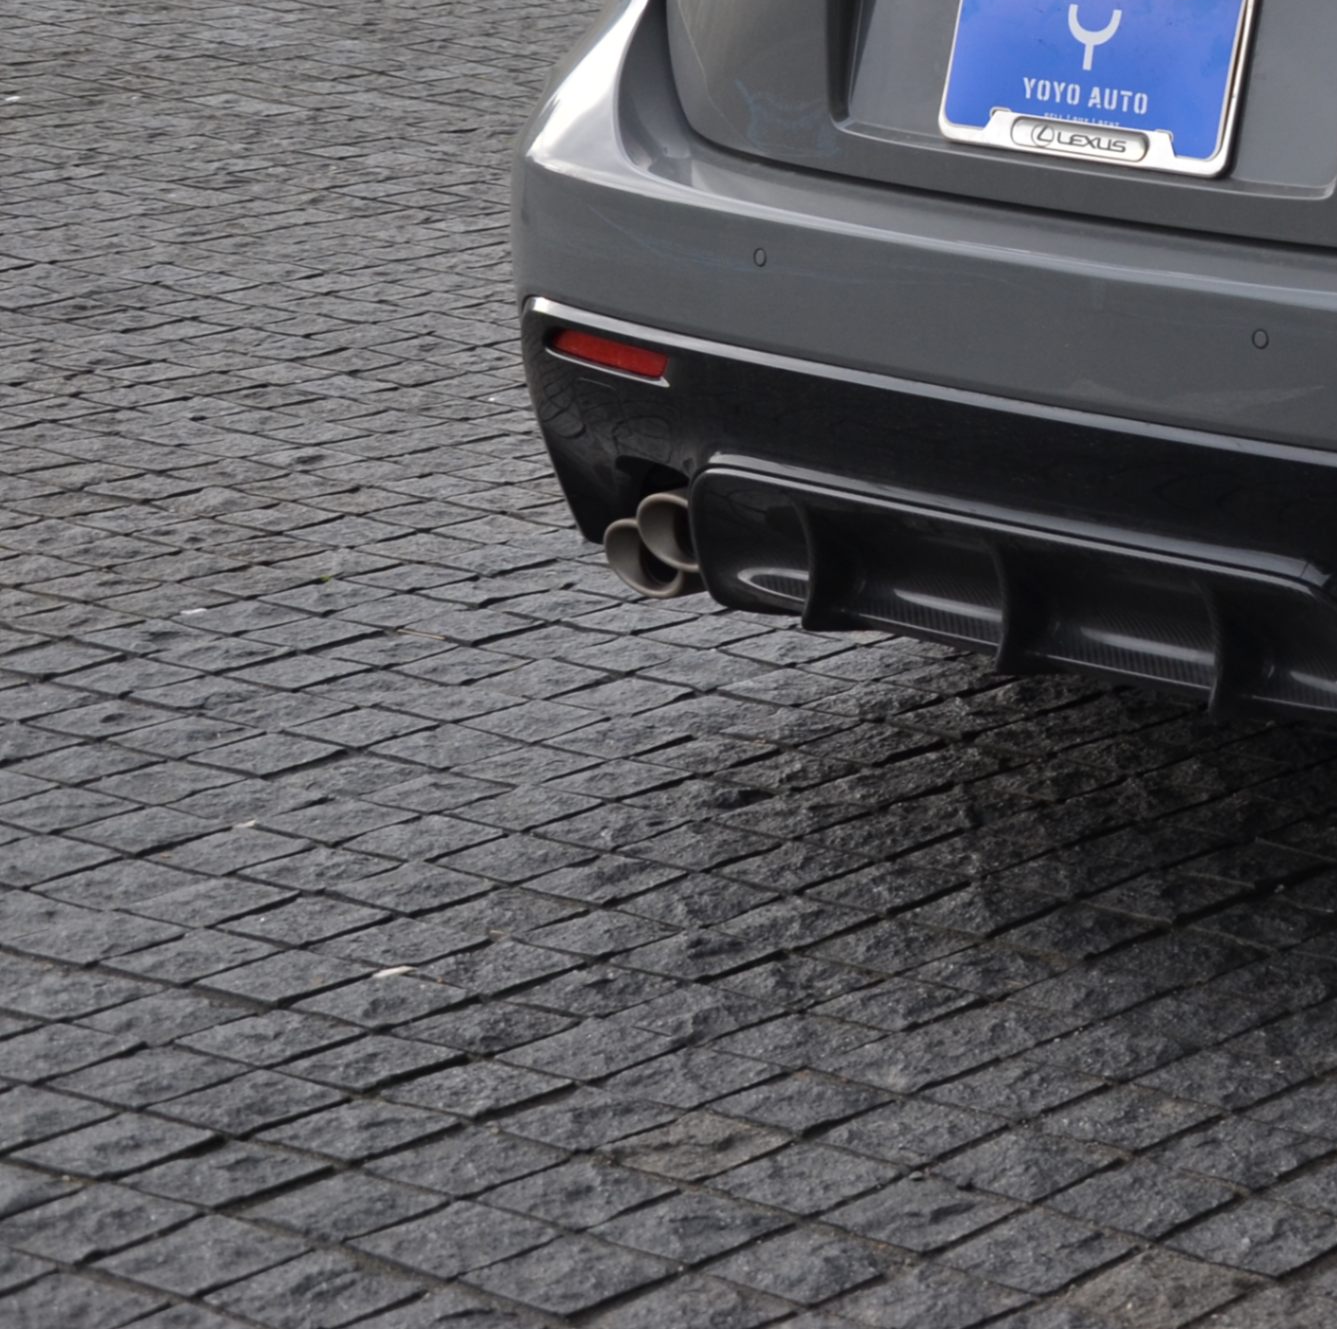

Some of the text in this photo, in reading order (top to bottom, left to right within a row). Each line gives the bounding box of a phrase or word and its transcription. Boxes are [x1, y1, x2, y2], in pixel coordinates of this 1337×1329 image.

[1023, 76, 1149, 115] YOYO AUTO
[1056, 131, 1128, 154] LEXUS
